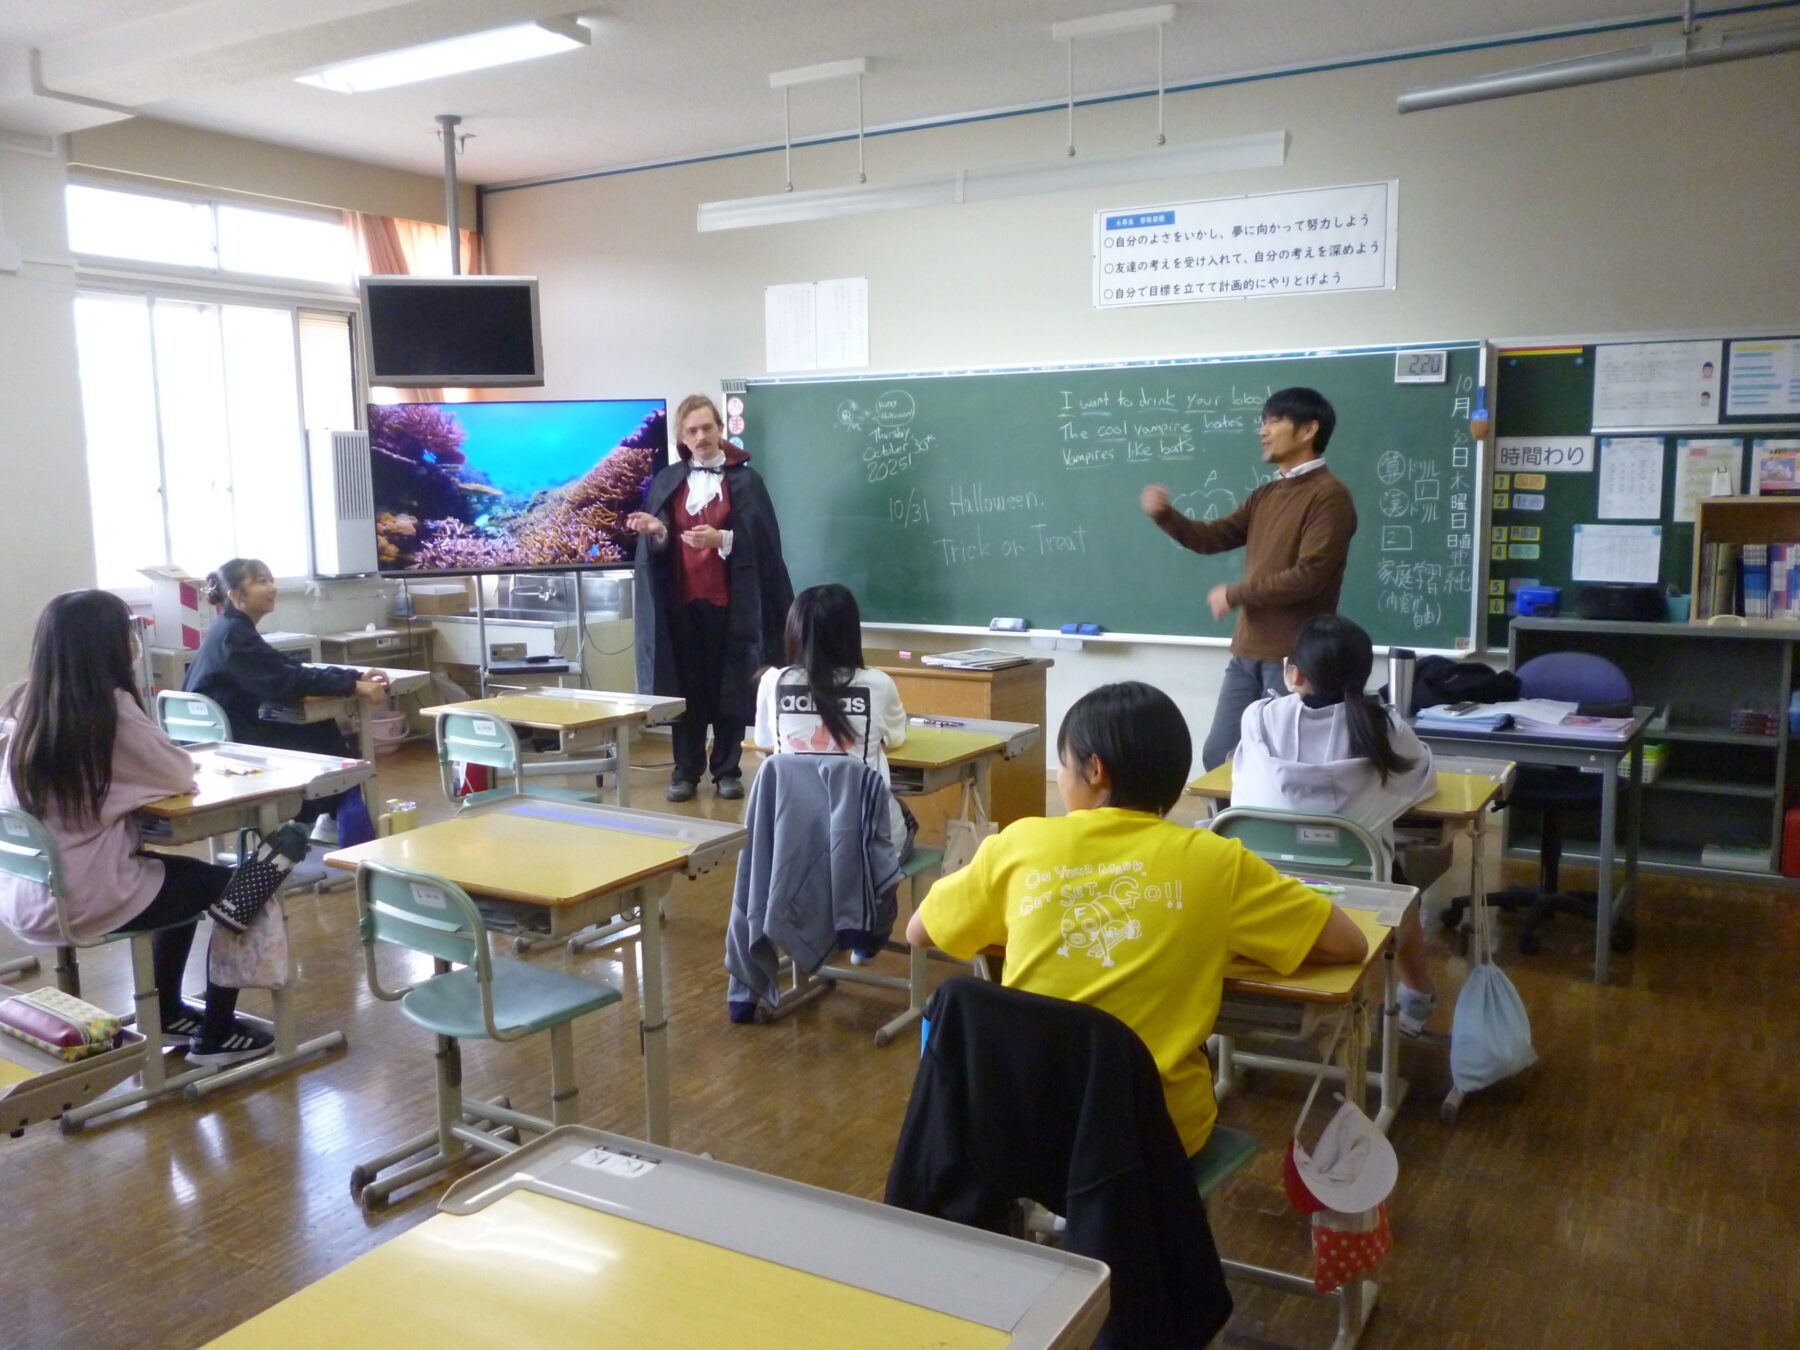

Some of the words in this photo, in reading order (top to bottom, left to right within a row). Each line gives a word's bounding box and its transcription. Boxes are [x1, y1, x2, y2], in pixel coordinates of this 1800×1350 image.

[1060, 391, 1072, 409] I
[1080, 391, 1109, 409] want
[1118, 390, 1133, 407] to
[1139, 386, 1176, 407] drink
[1187, 393, 1220, 409] your
[1058, 421, 1088, 441] The
[1097, 420, 1127, 437] cool
[1203, 413, 1243, 429] hates
[1127, 440, 1152, 457] like
[1500, 447, 1584, 467] 時間わり
[889, 487, 930, 528] 10/31
[932, 524, 990, 566] Trick
